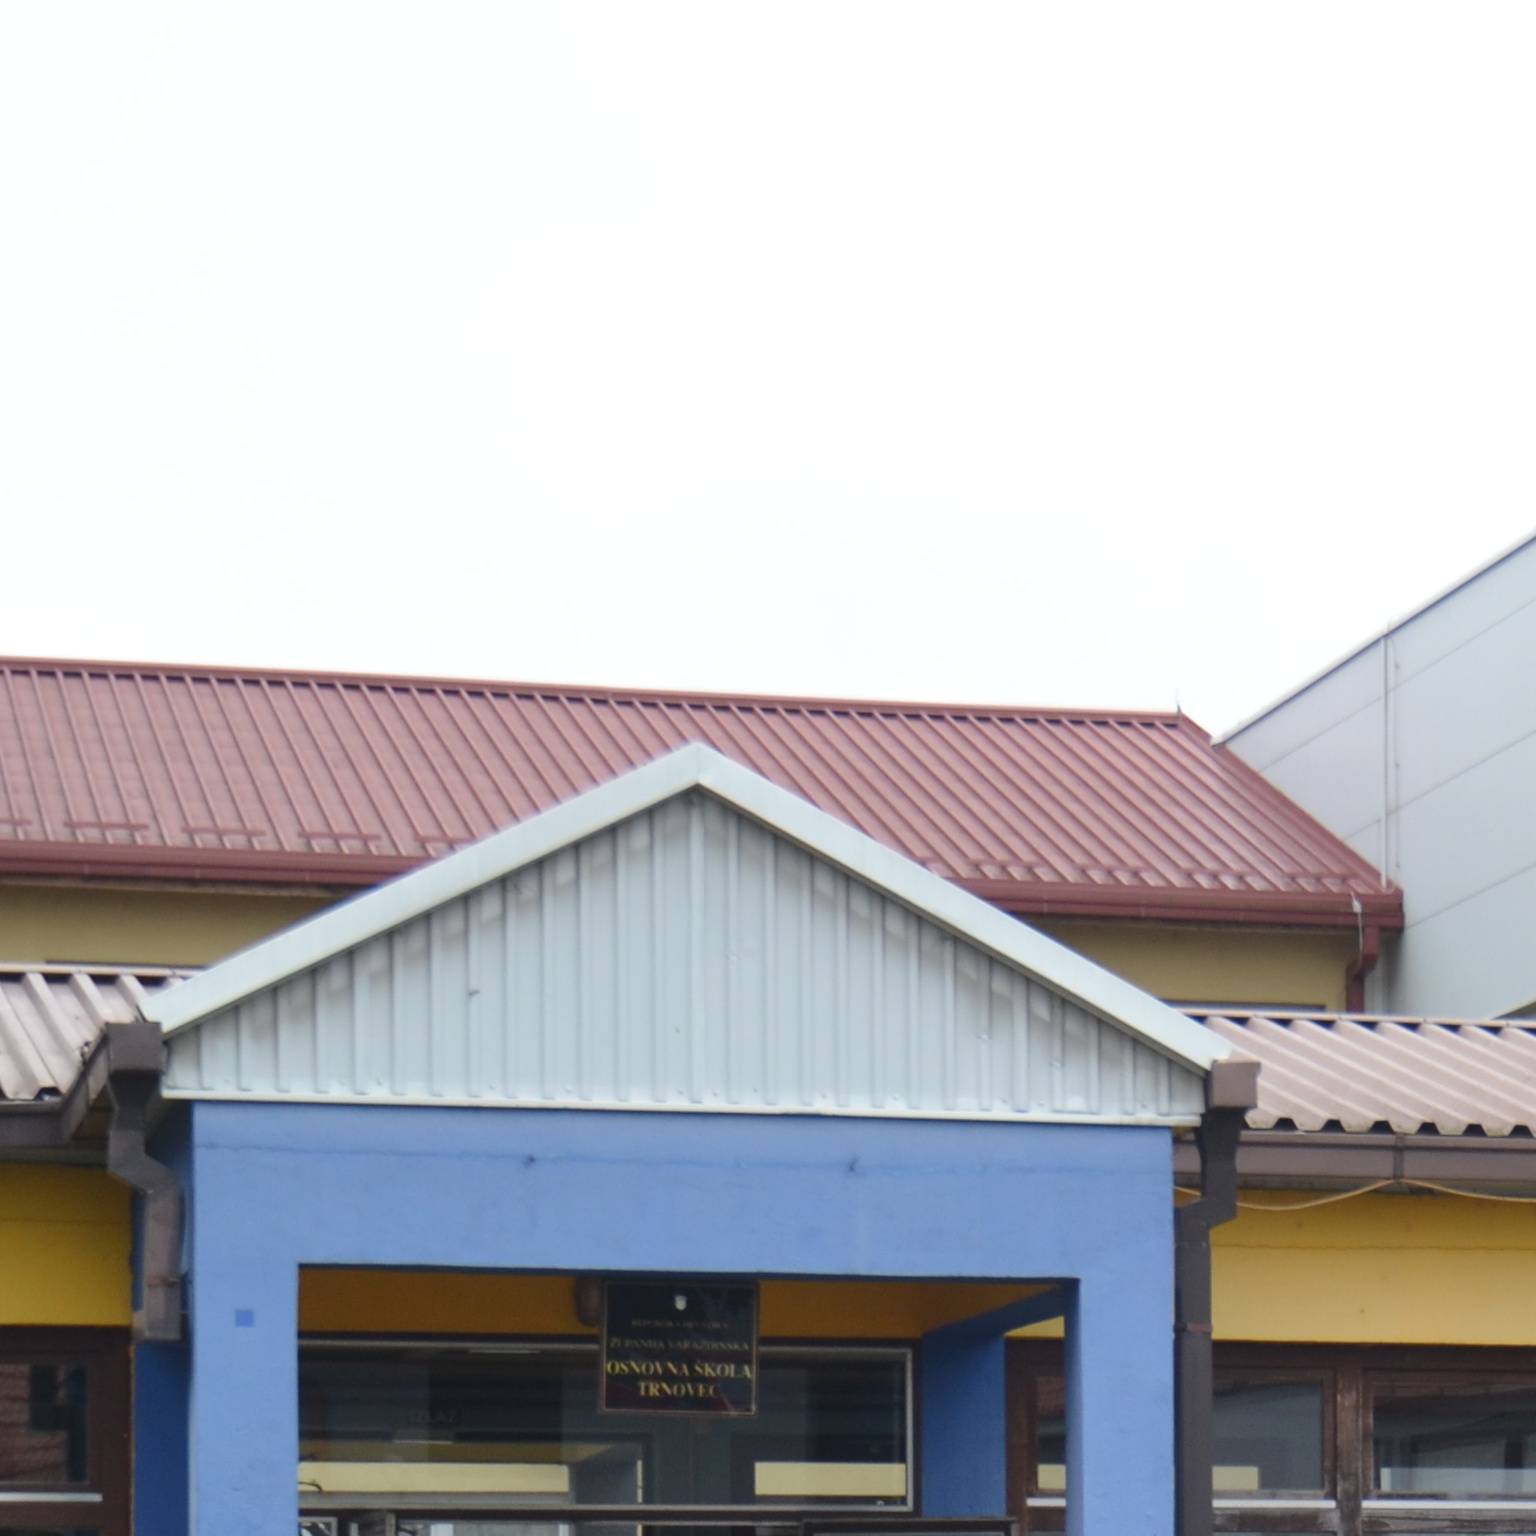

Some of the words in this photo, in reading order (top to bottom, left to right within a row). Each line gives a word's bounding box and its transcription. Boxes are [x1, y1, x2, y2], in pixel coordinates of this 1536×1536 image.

[606, 1360, 689, 1376] OSNOVNA
[694, 1359, 752, 1379] ŠKOLA
[637, 1381, 720, 1398] TRNOVEC
